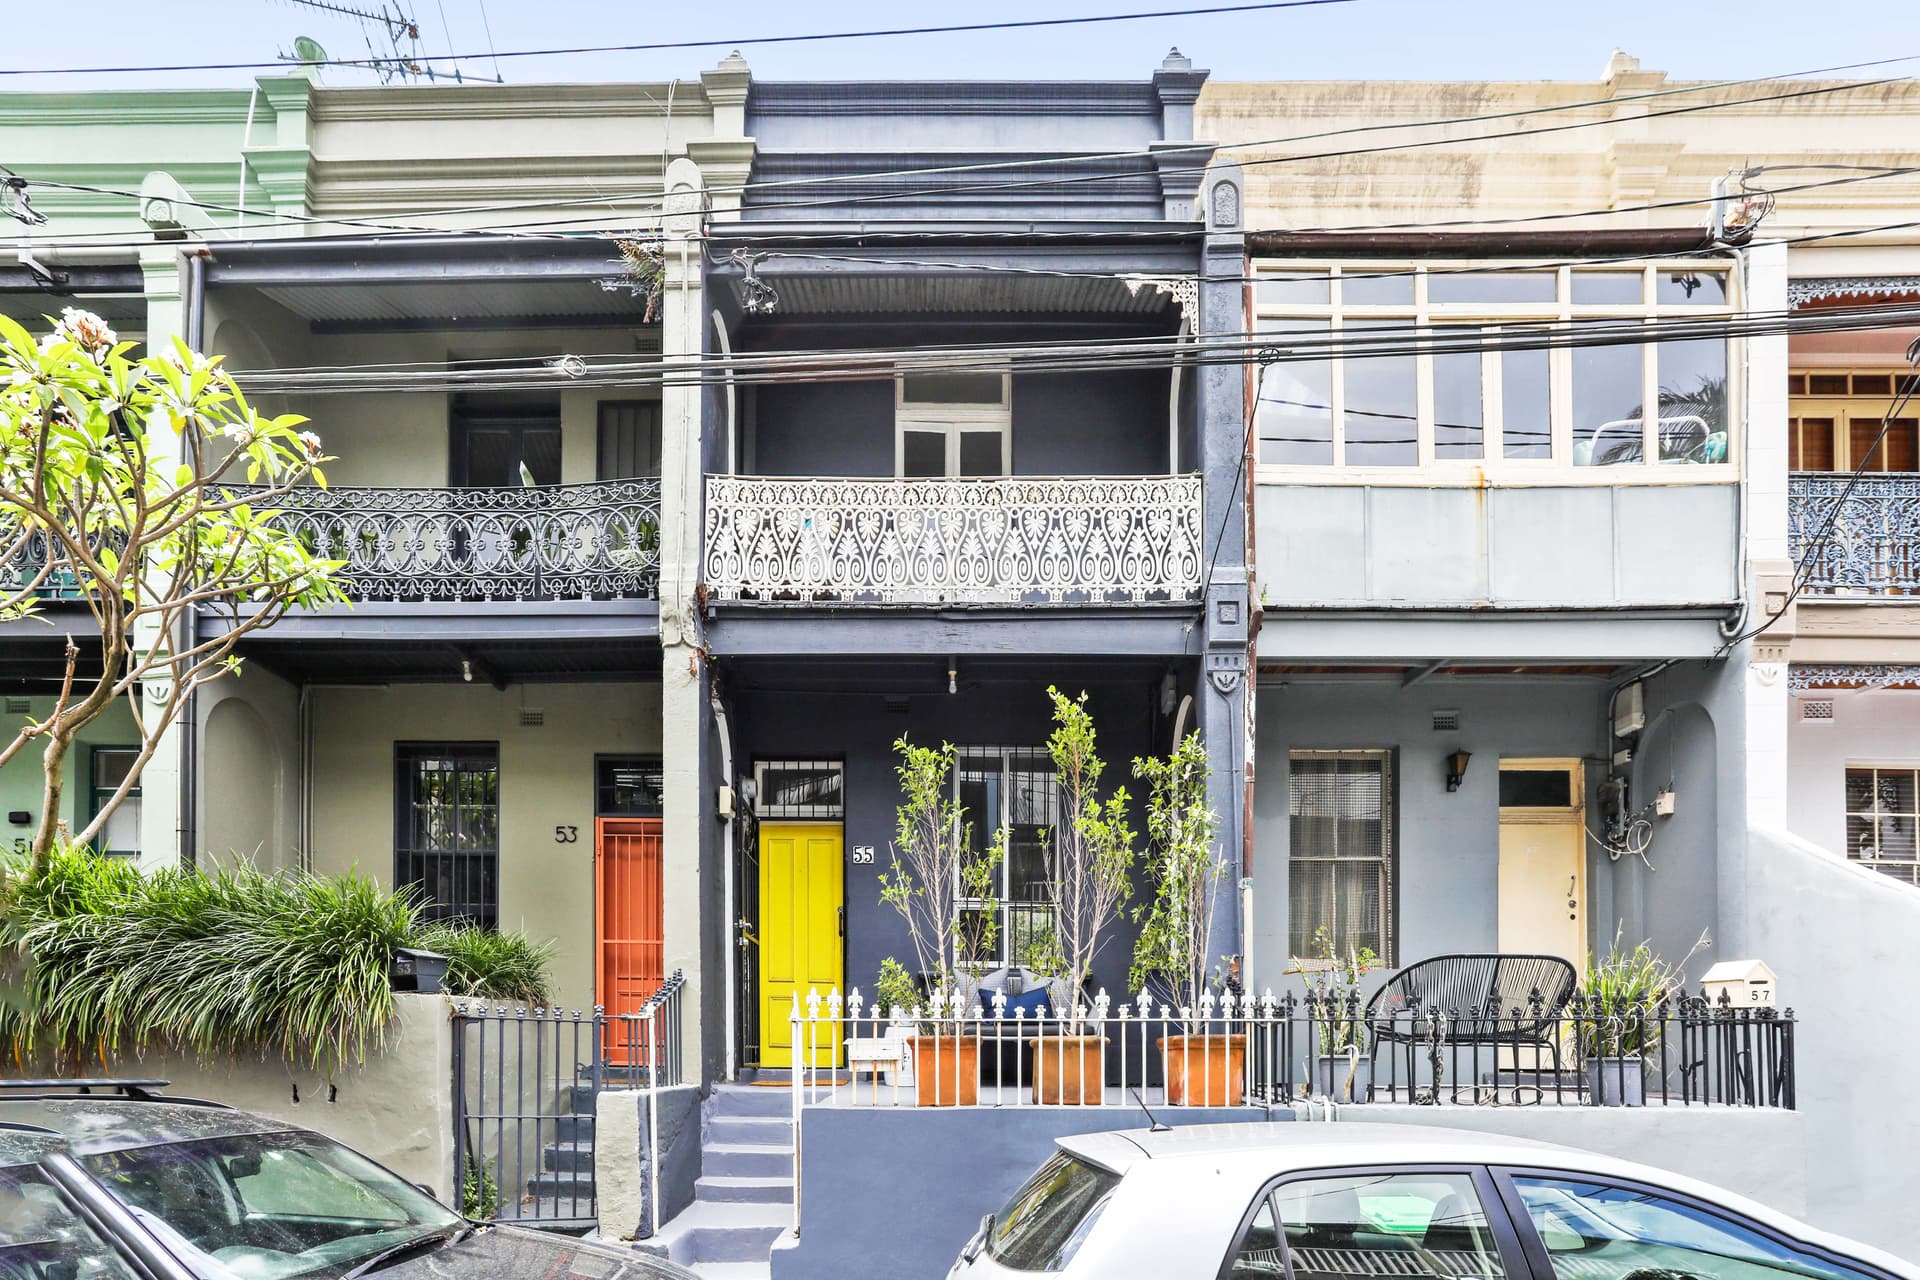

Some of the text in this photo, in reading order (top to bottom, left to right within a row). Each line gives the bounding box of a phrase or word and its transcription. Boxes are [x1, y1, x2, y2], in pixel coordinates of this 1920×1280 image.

[555, 825, 577, 843] 53
[854, 846, 873, 863] 55
[397, 963, 411, 975] 53
